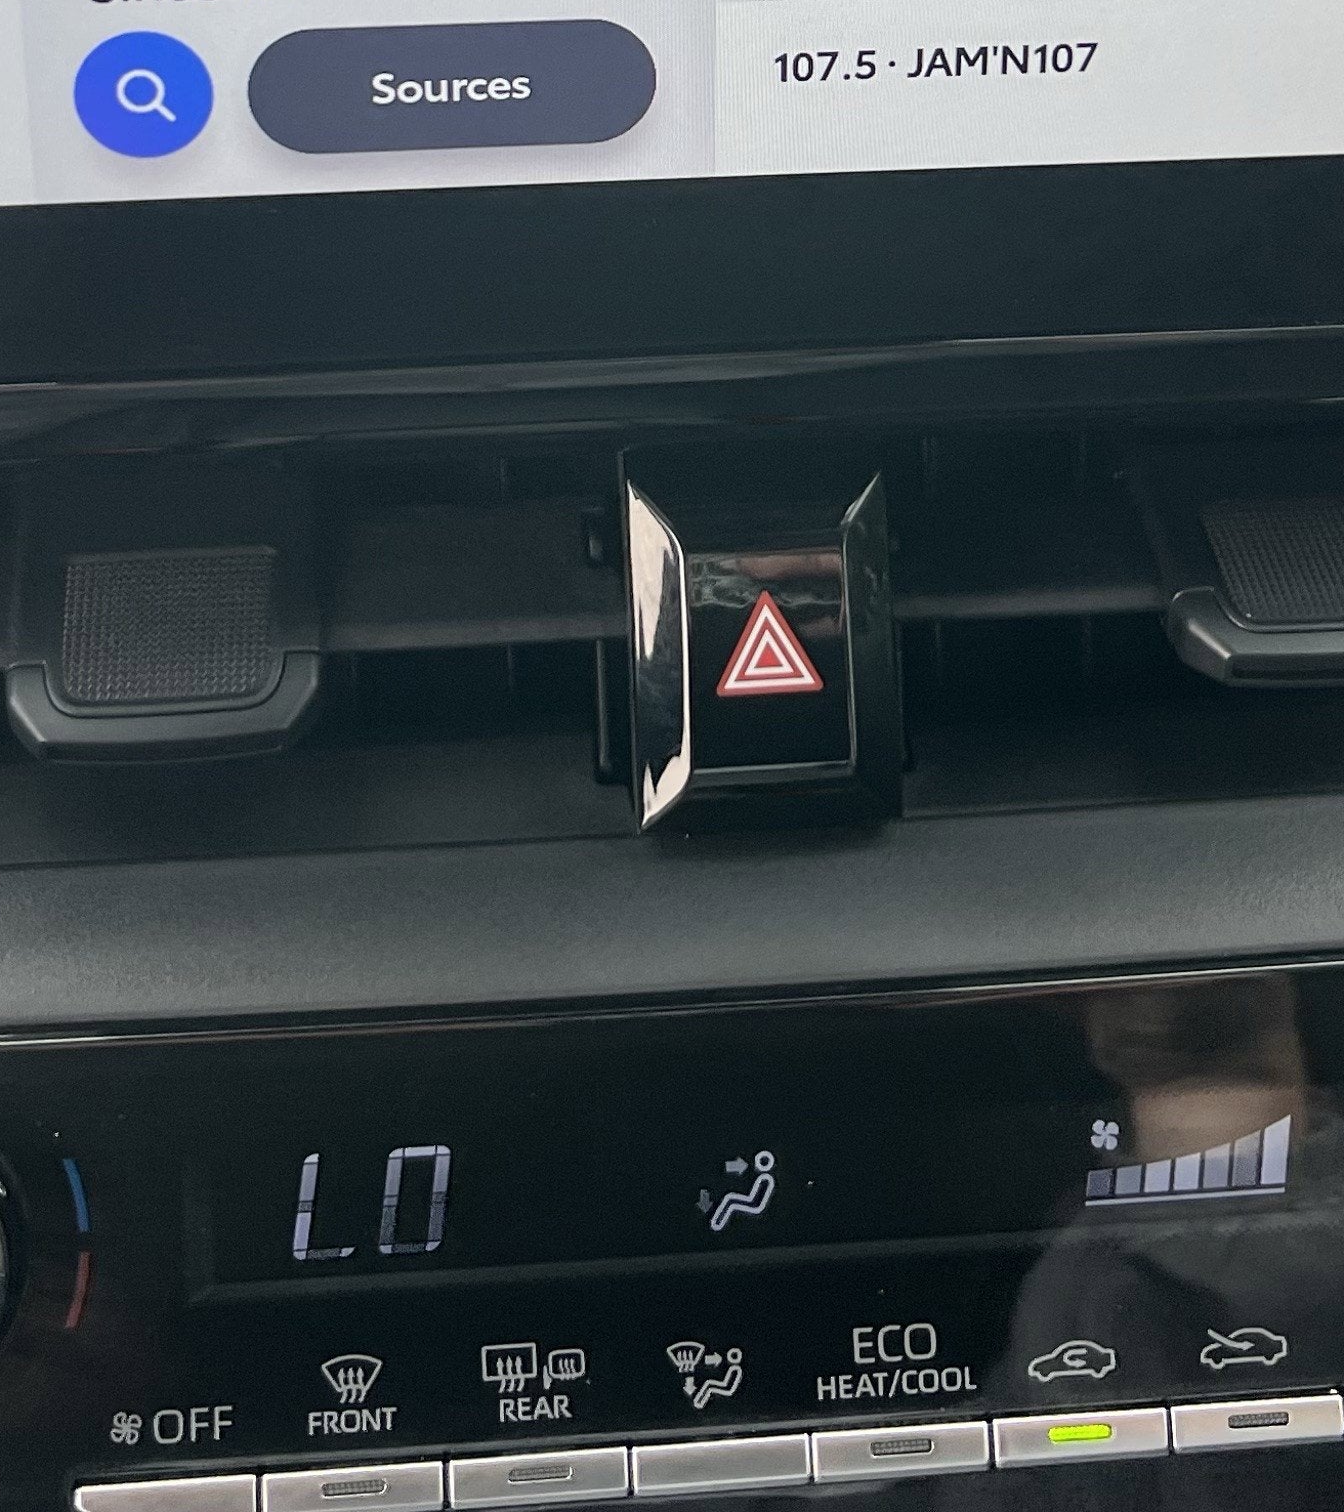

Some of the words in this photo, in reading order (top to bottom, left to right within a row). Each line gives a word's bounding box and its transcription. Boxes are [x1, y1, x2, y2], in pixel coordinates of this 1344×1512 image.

[774, 49, 877, 83] 107.5
[906, 42, 1099, 80] JAM'N107
[370, 72, 532, 106] Sources
[292, 1144, 452, 1262] LO
[852, 1322, 938, 1363] ECO
[816, 1365, 979, 1401] HEAT/COOL
[152, 1405, 234, 1445] OFF
[307, 1404, 398, 1437] FRONT
[498, 1393, 572, 1423] REAR
